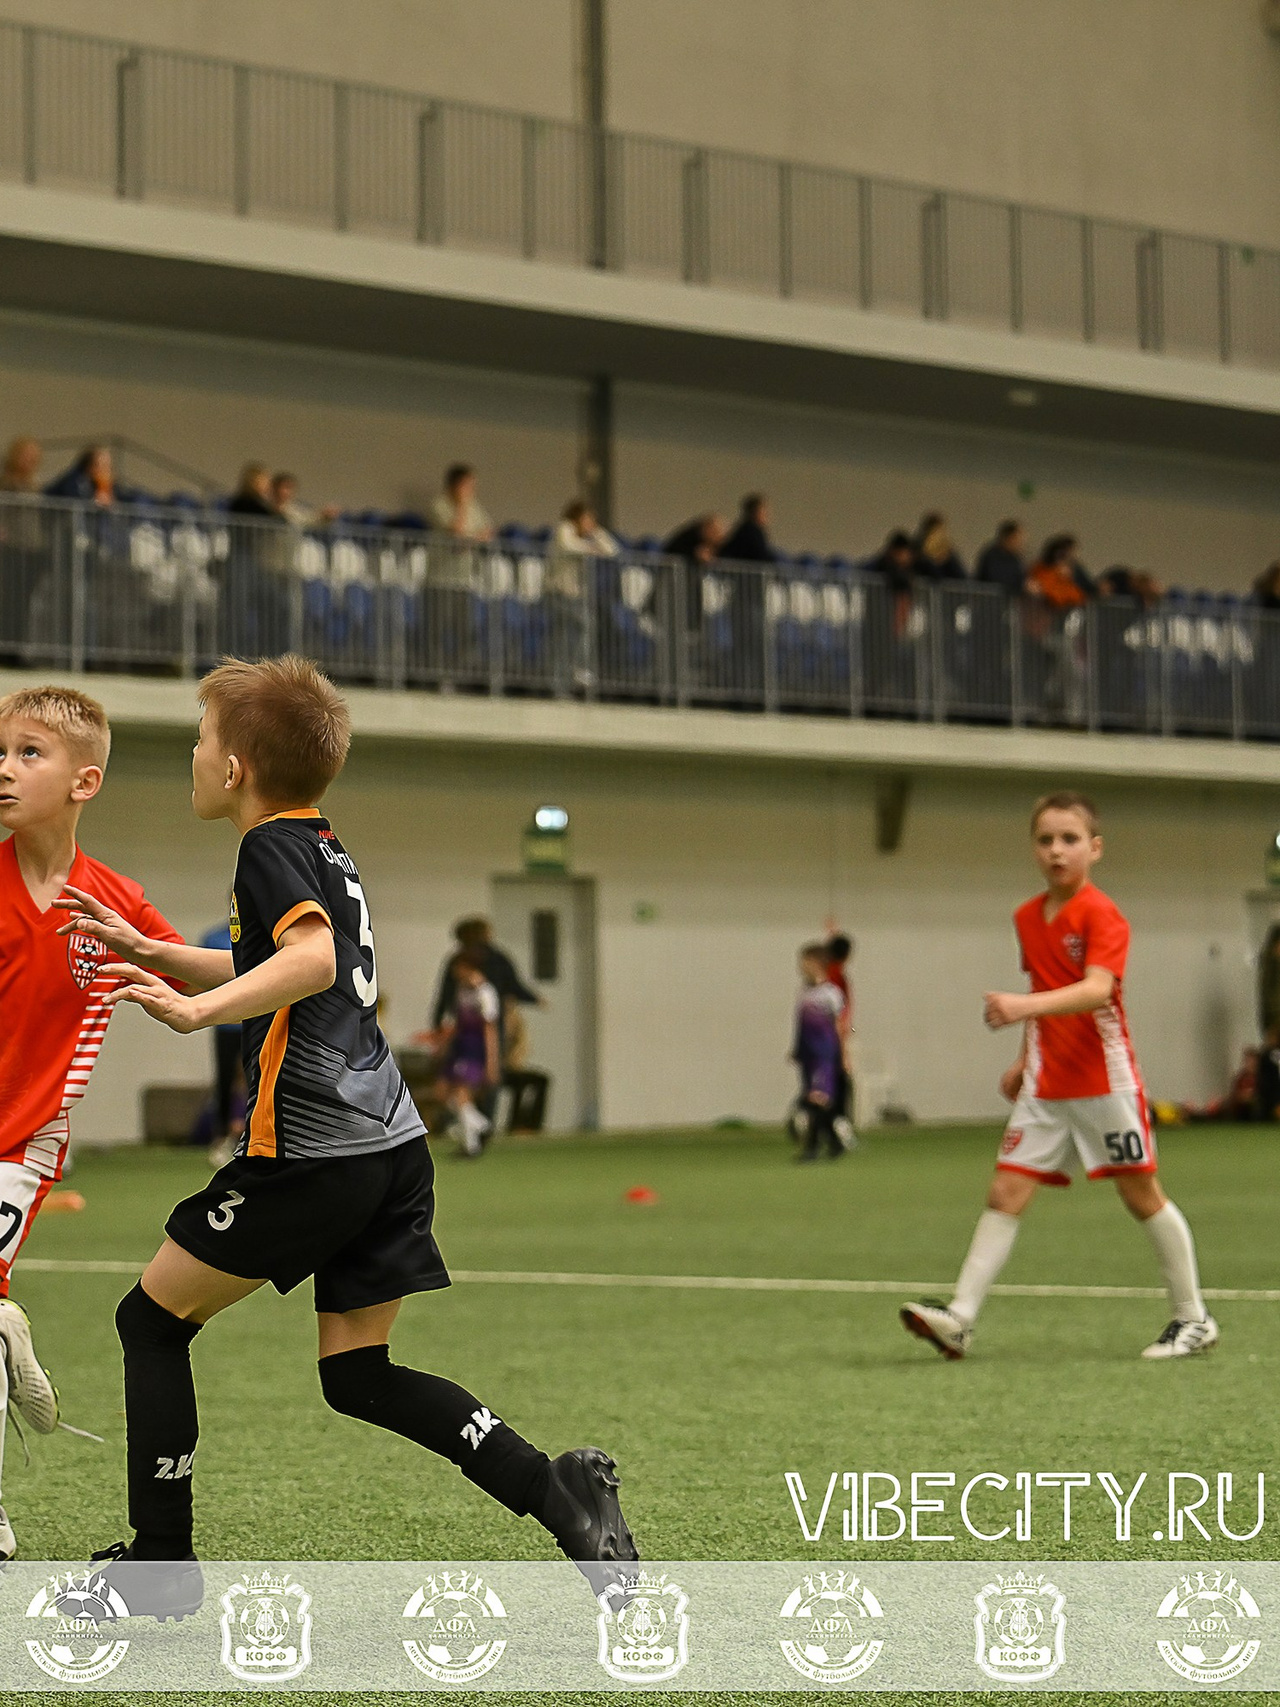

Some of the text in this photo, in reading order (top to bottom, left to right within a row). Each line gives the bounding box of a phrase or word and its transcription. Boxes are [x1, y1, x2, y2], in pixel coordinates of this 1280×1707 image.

[344, 876, 378, 1008] 3
[1104, 1131, 1145, 1163] 50
[207, 1190, 246, 1231] 3
